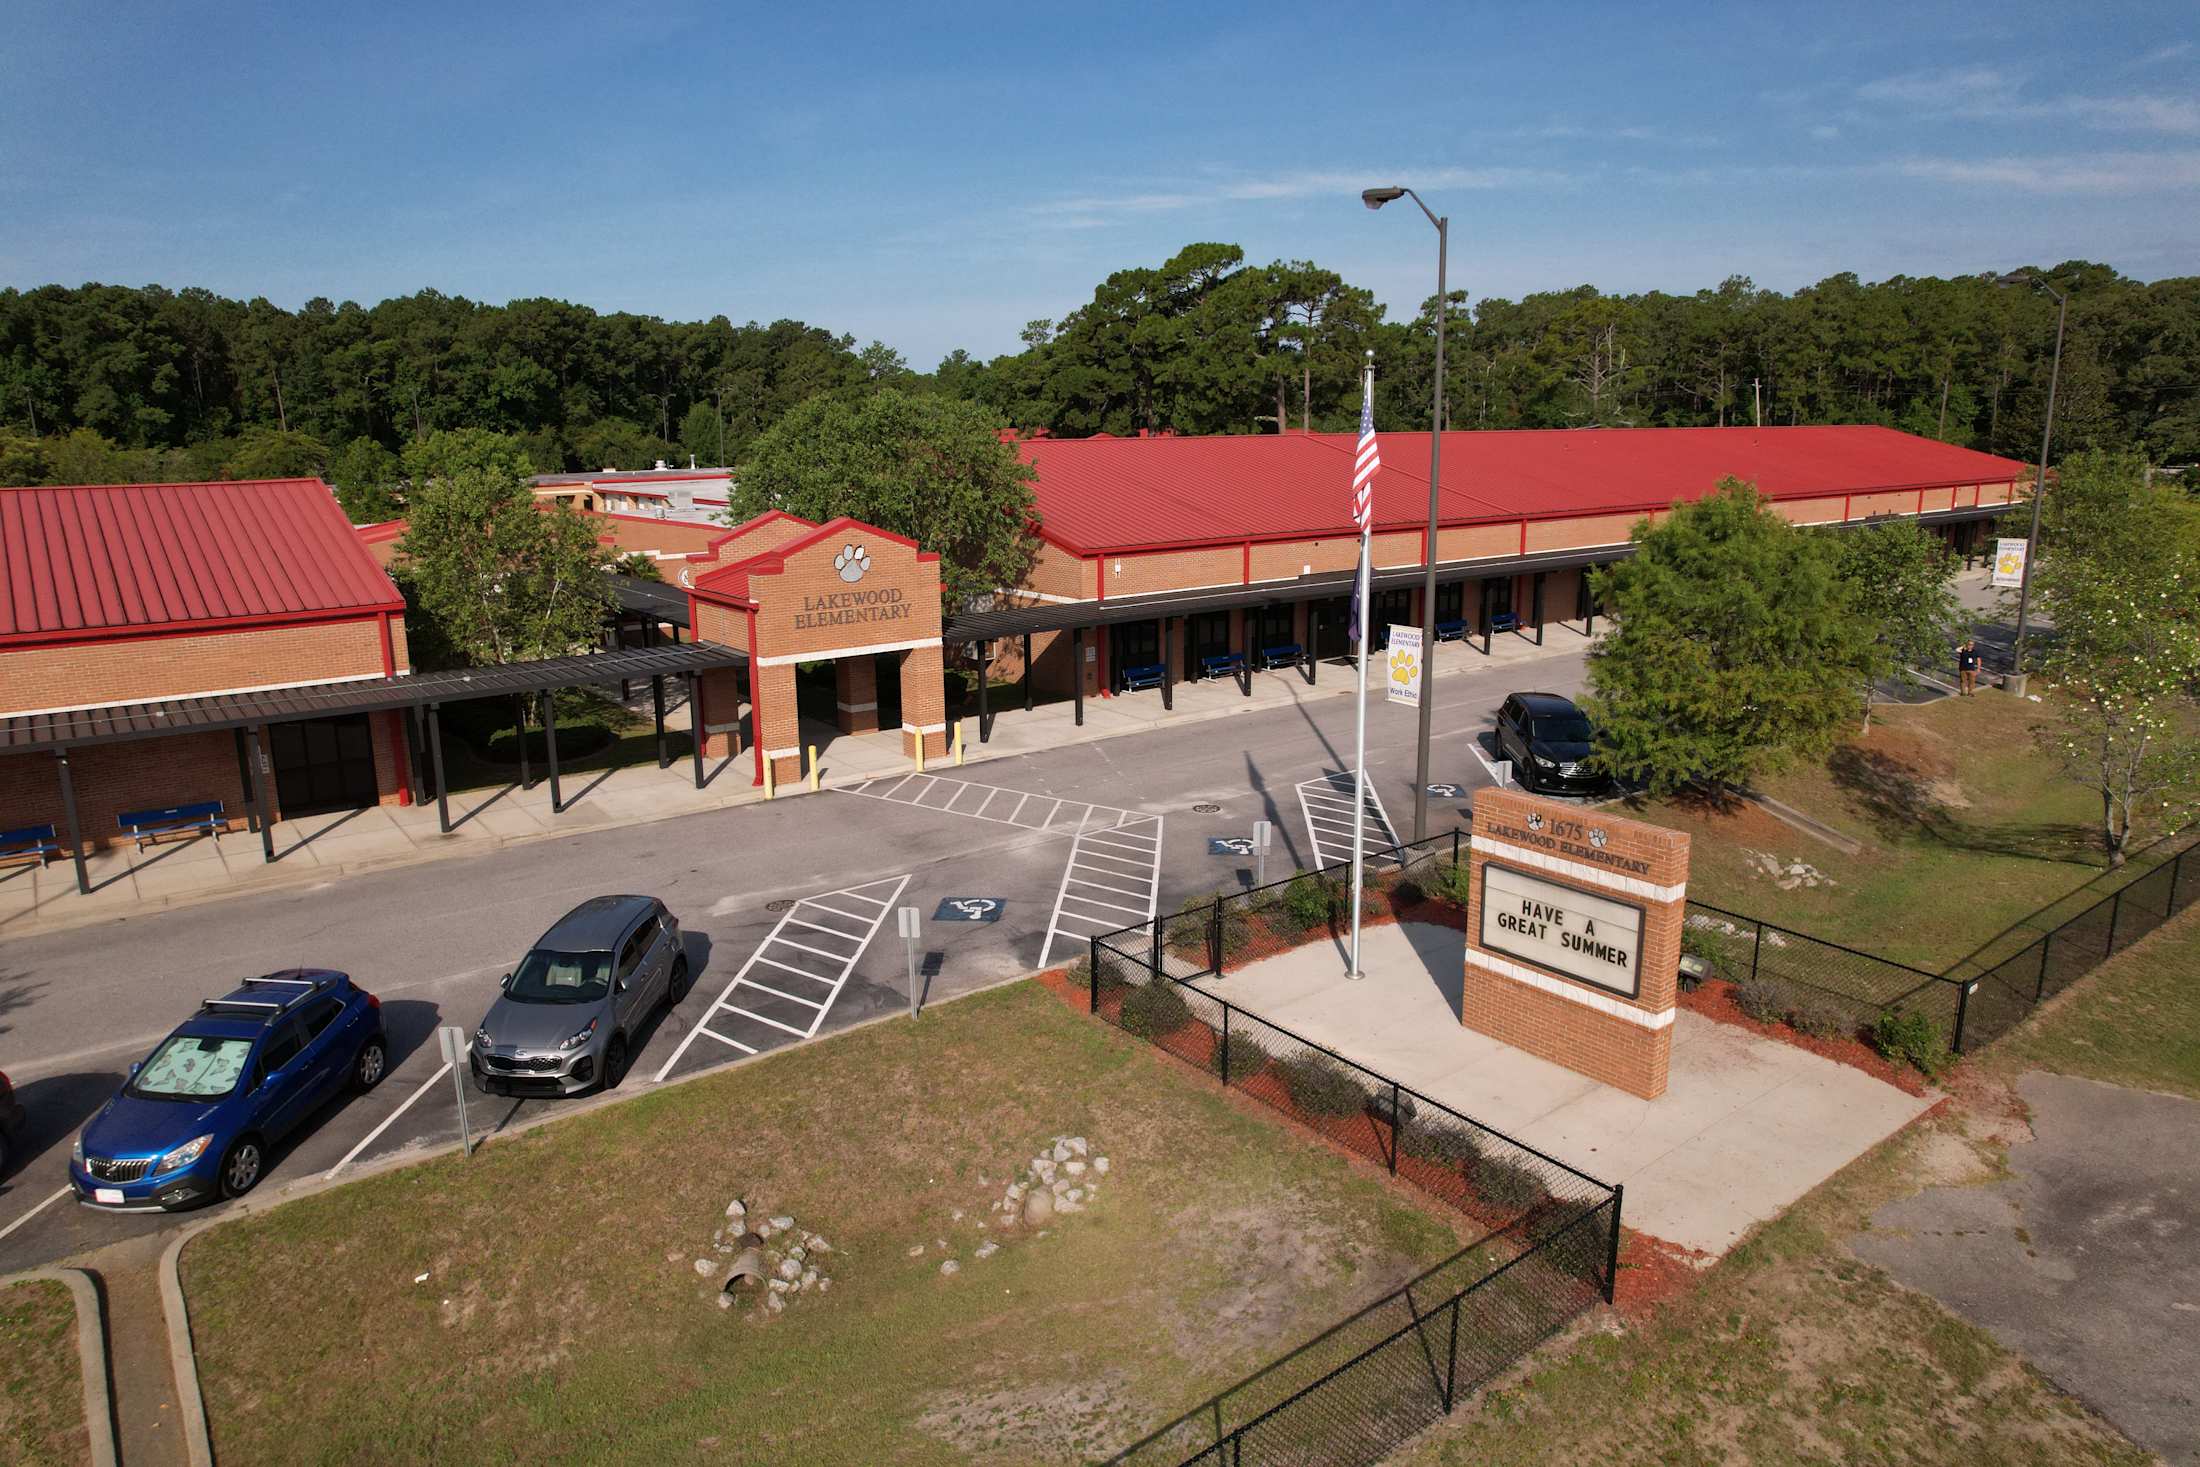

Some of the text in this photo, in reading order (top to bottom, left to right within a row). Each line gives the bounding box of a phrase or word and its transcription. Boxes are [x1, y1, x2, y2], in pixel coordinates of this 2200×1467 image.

[804, 588, 902, 611] LAKEWOOD
[794, 603, 912, 629] ELEMENTARY
[1391, 638, 1420, 648] ELEMENTARY
[1392, 631, 1421, 641] LAKEWOOD
[1390, 687, 1403, 696] Work
[1549, 818, 1583, 841] 1675
[1487, 822, 1649, 875] LAKEWOOD ELEMENTARY
[1522, 899, 1595, 937] HAVE A
[1498, 912, 1628, 968] GREAT SUMMER
